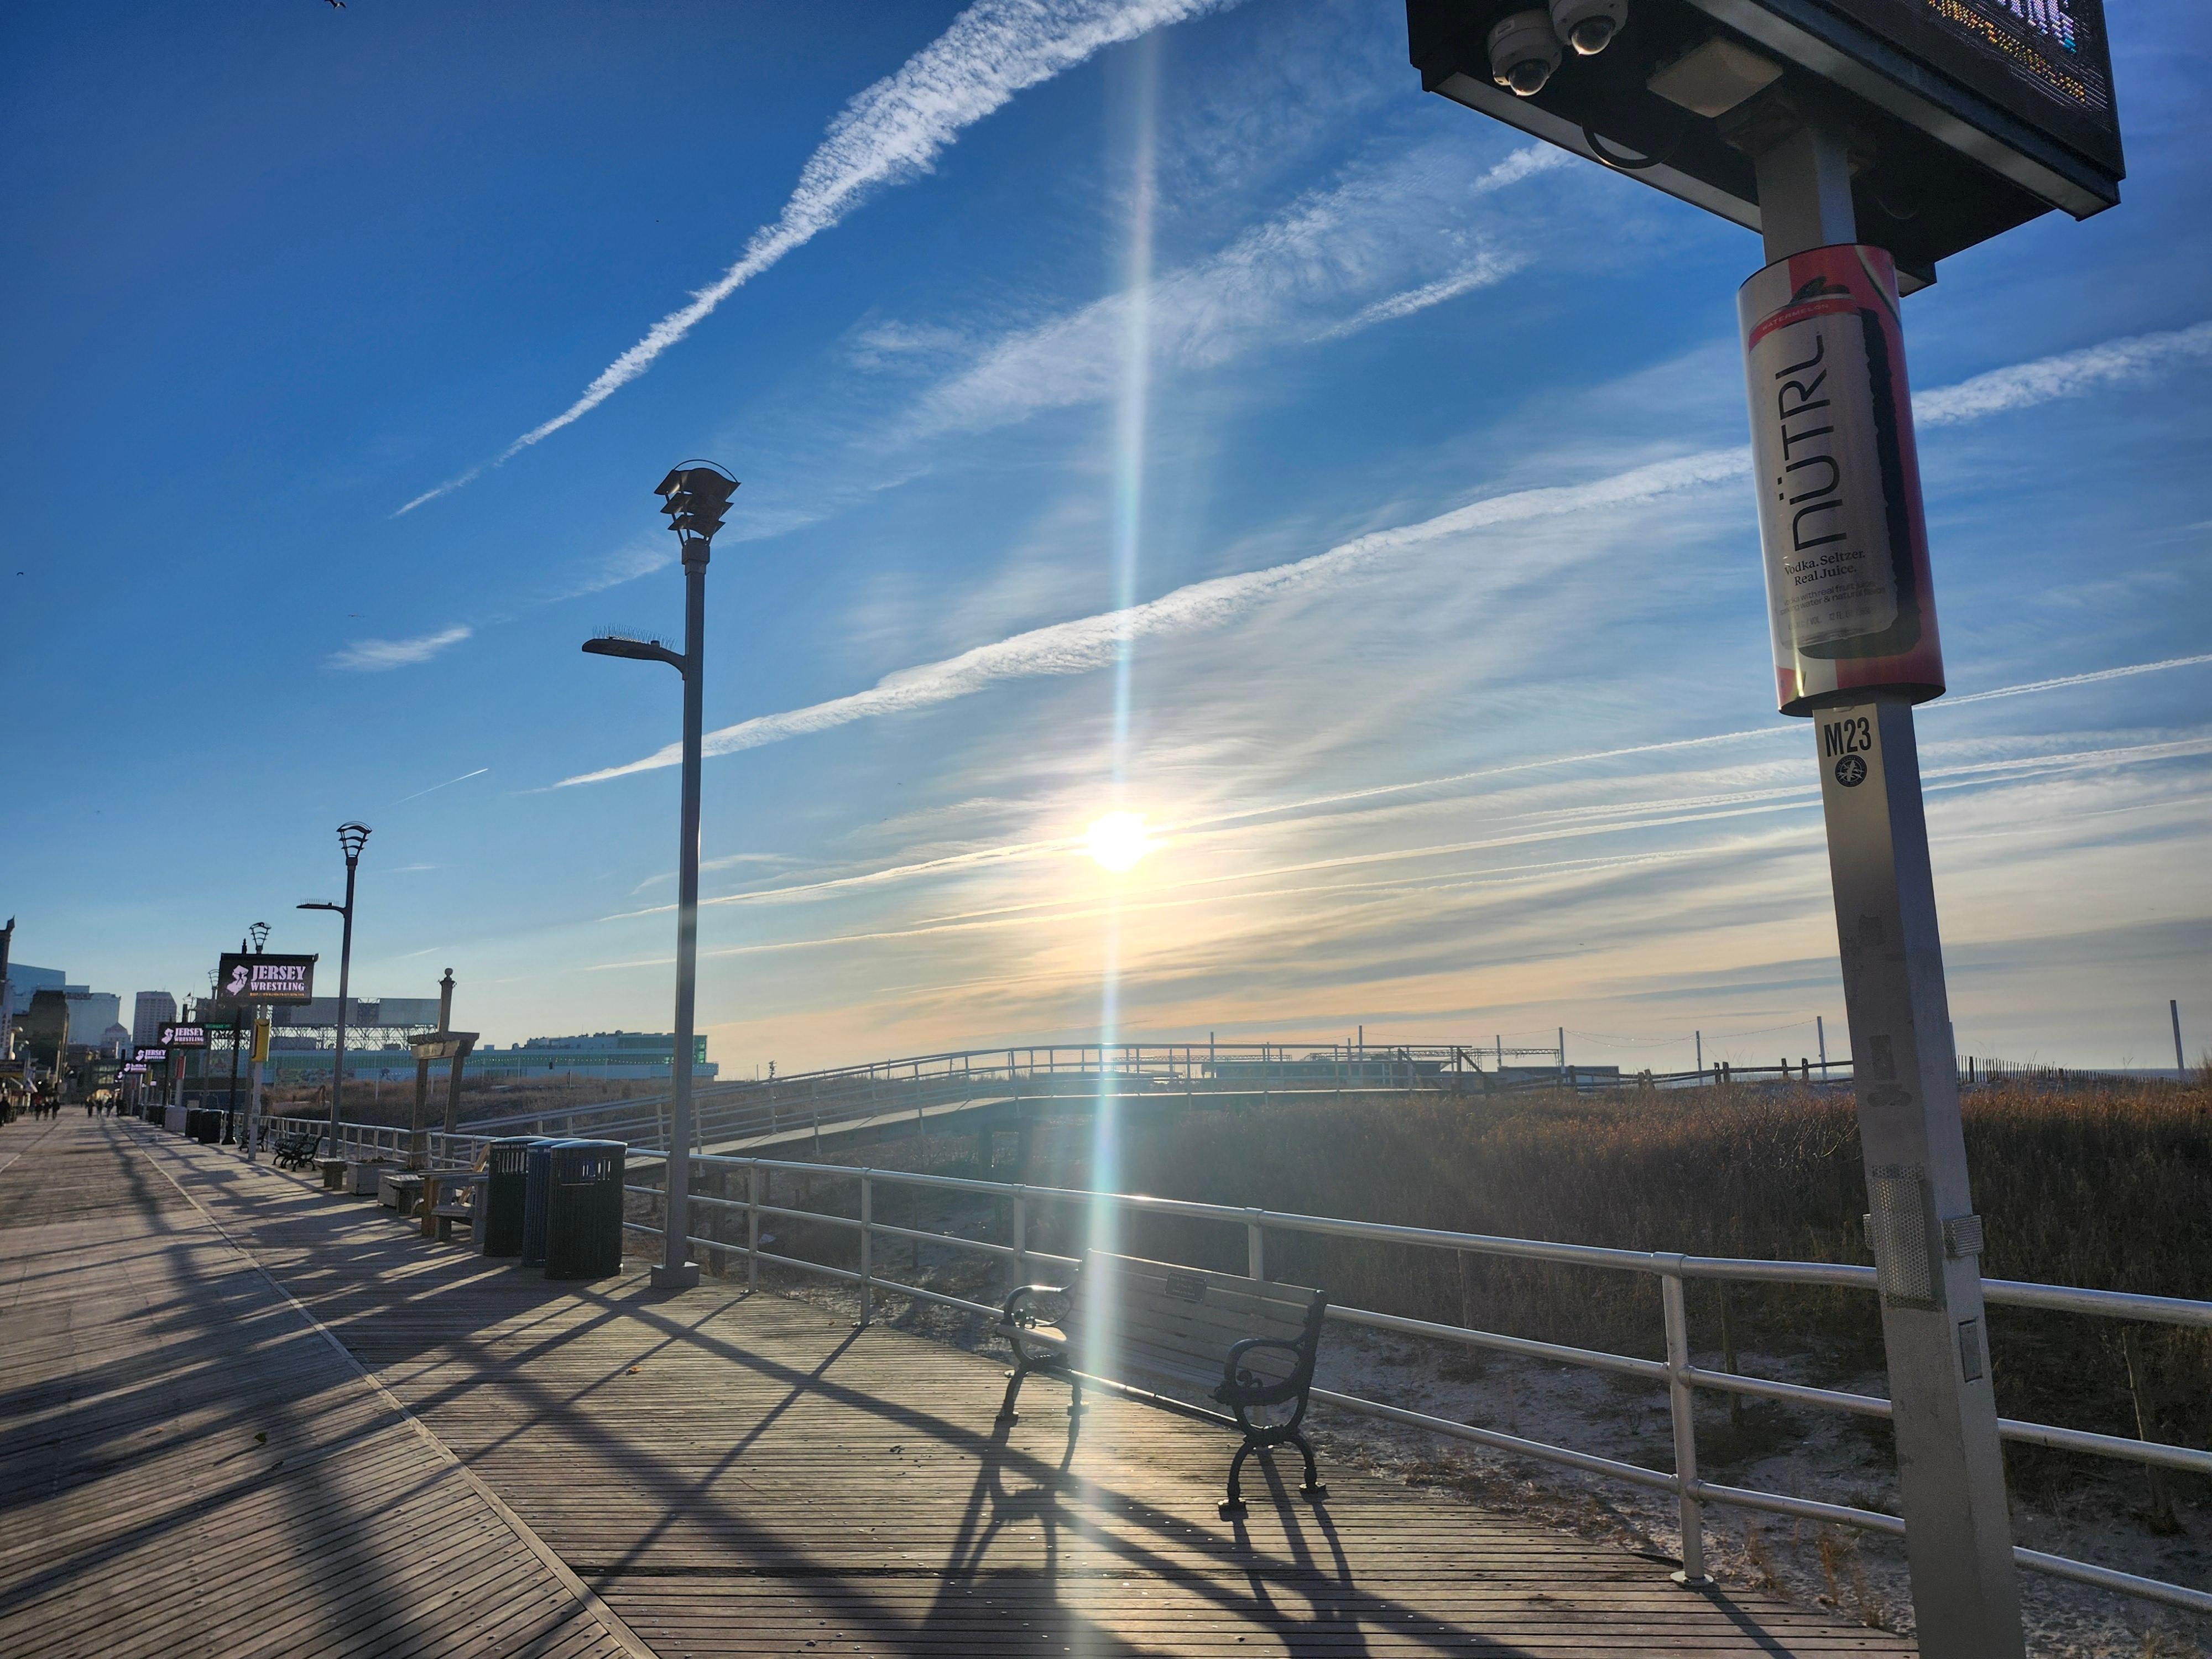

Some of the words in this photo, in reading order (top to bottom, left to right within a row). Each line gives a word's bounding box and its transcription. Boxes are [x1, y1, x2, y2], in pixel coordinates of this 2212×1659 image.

[1762, 304, 1829, 331] WATERMELON
[1784, 559, 1819, 575] Vodka.
[1820, 550, 1866, 565] Seltzer.
[1794, 570, 1818, 586] Real
[1819, 564, 1857, 578] Juice.
[1800, 591, 1817, 601] with
[1818, 586, 1834, 596] real
[1800, 598, 1822, 609] water
[1824, 717, 1872, 758] M23
[251, 965, 306, 981] JERSEY
[250, 982, 305, 992] WRESTLING
[175, 1027, 204, 1037] JERSEY
